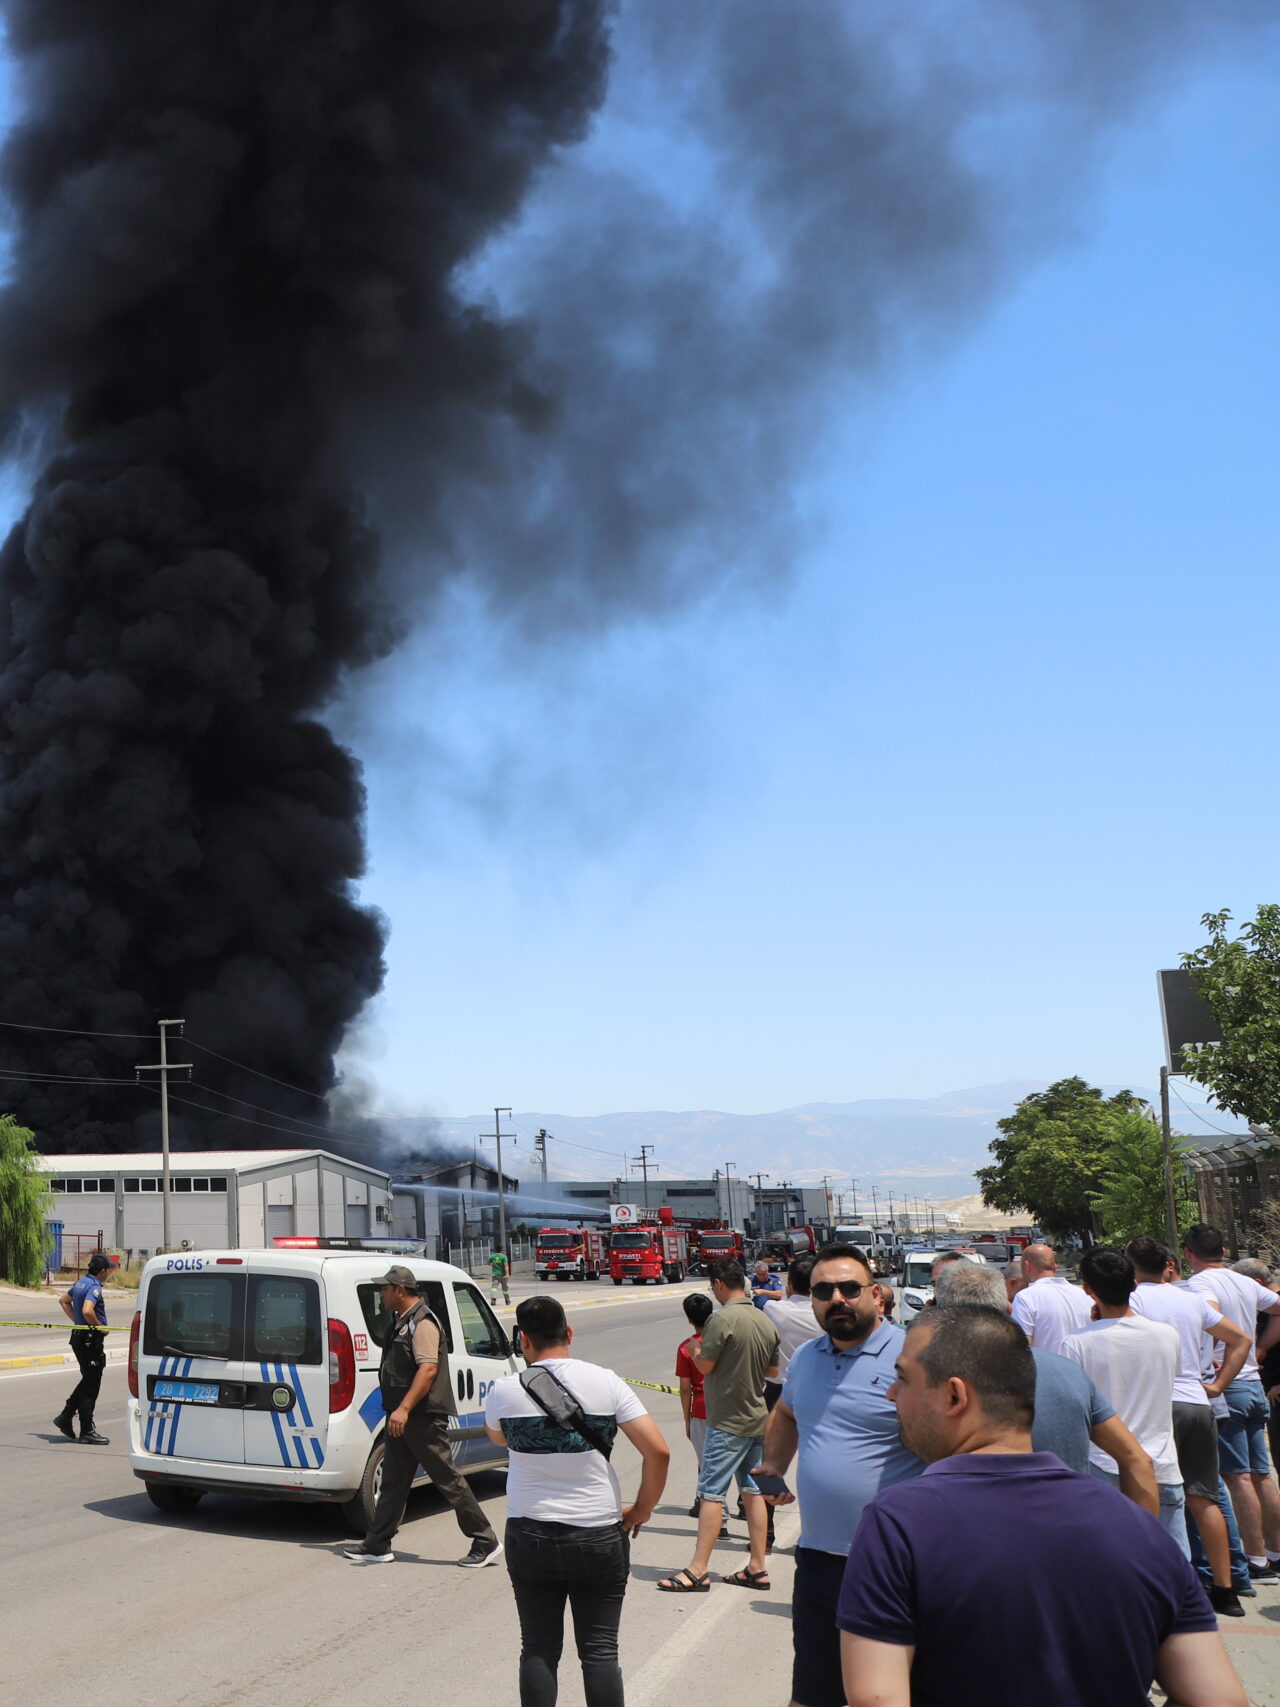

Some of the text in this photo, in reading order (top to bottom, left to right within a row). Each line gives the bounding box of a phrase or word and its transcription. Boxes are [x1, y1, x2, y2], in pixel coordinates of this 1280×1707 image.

[356, 1336, 366, 1349] 112
[160, 1384, 218, 1398] 20 A 7292
